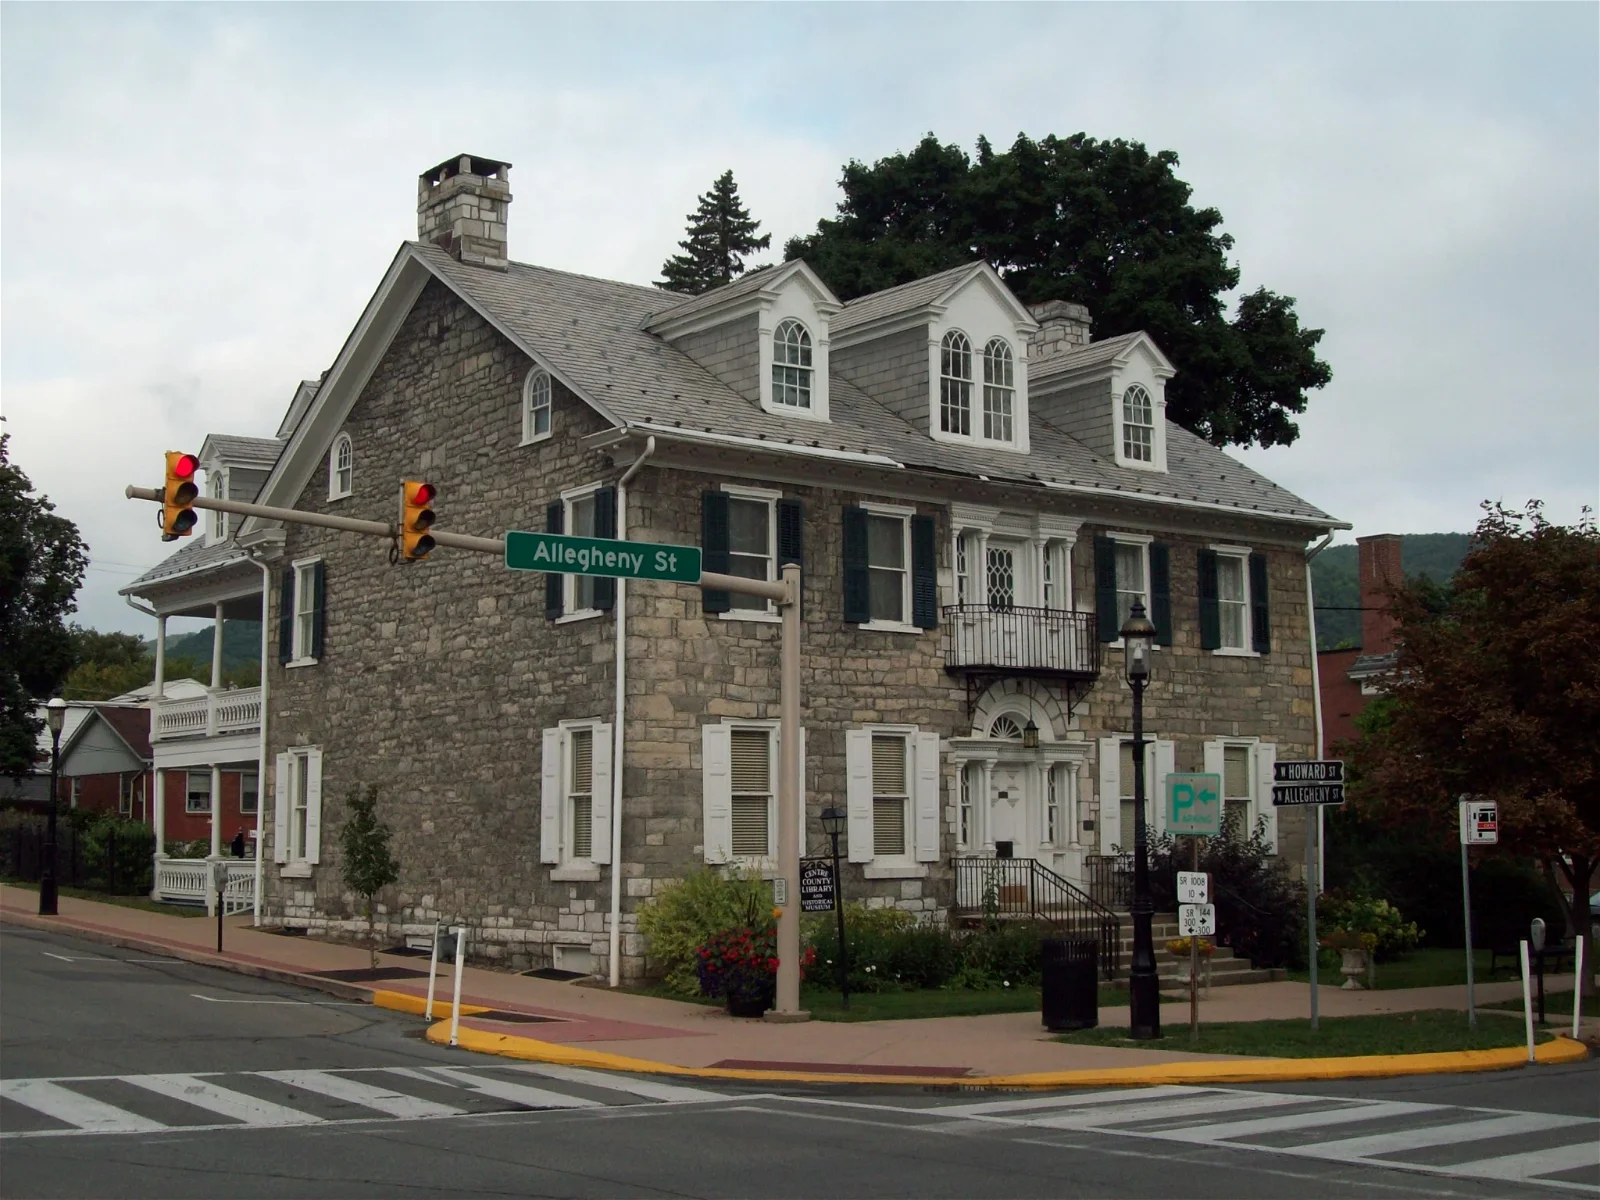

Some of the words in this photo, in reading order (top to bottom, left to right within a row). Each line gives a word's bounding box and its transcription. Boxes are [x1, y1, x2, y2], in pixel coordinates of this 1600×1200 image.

[533, 541, 644, 574] Allegheny
[654, 551, 677, 572] St
[1280, 766, 1286, 777] W
[1288, 764, 1326, 779] HOWARD
[1329, 766, 1336, 777] ST
[1284, 786, 1330, 803] ALLEGHENY
[1332, 788, 1339, 799] ST
[804, 868, 829, 878] CENTRE
[802, 877, 832, 886] COUNTY
[1180, 876, 1187, 885] SR
[1191, 876, 1205, 886] 1008
[801, 885, 833, 893] LIBRARY
[1188, 890, 1195, 898] 10
[1186, 909, 1194, 917] SR
[1200, 909, 1210, 917] 144
[1184, 918, 1195, 927] 300
